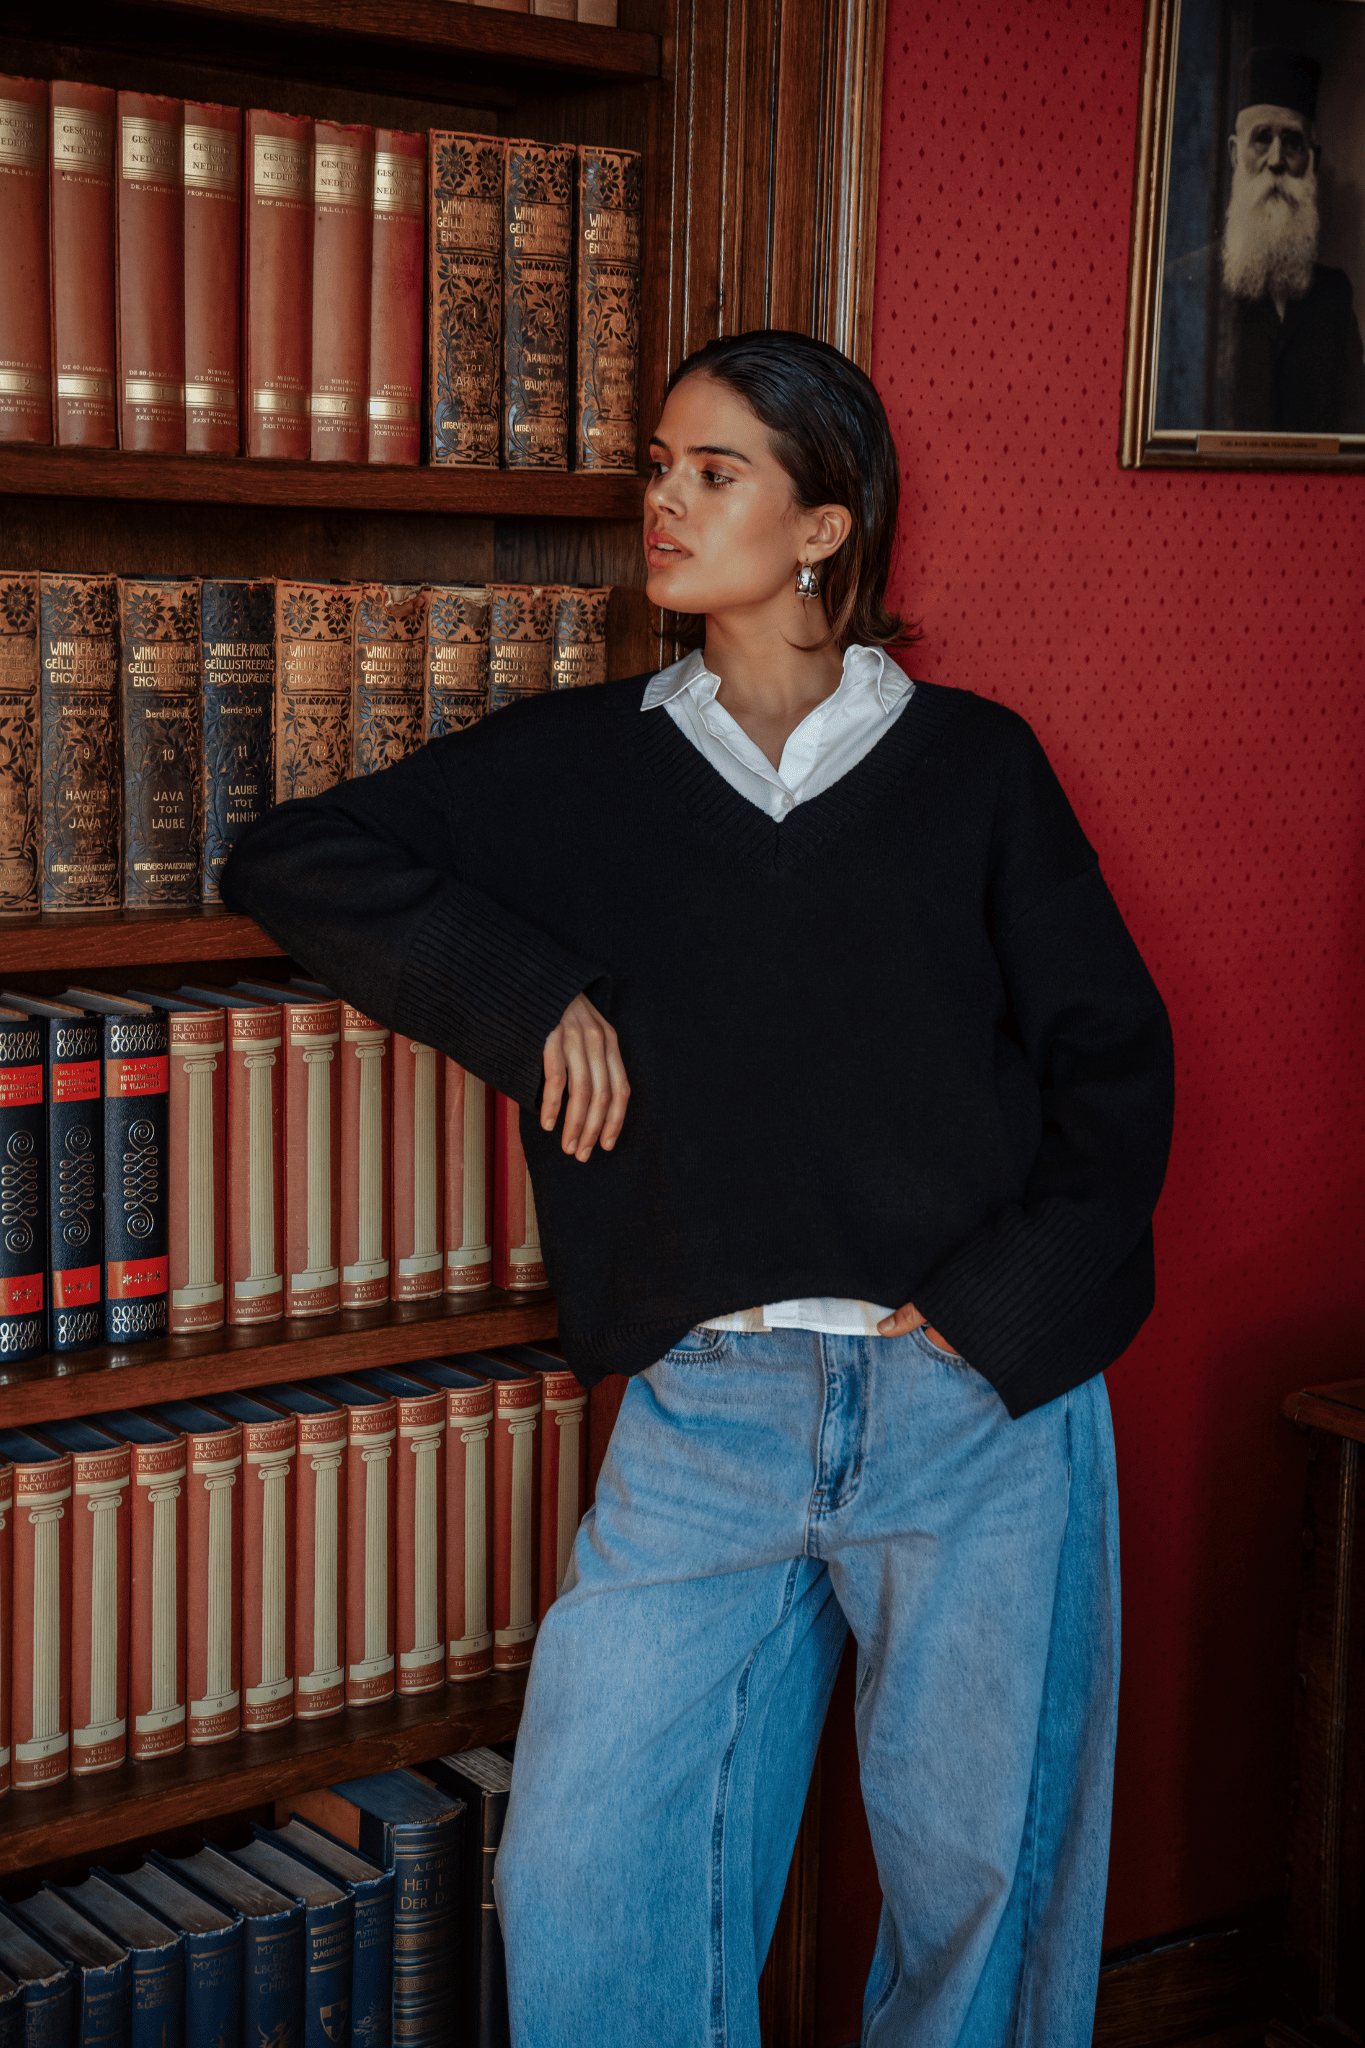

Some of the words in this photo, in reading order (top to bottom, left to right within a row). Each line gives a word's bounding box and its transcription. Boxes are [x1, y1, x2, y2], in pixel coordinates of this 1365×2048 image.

[12, 129, 31, 139] VAN
[82, 137, 100, 147] VAN
[151, 147, 169, 156] VAN
[211, 154, 228, 164] VAN
[281, 164, 298, 174] VAN
[339, 172, 356, 180] VAN
[395, 180, 410, 188] VAN
[257, 198, 274, 206] PROF.
[472, 307, 476, 318] 1
[543, 312, 550, 324] 2
[470, 350, 477, 360] A
[466, 364, 482, 372] TOT
[536, 366, 554, 376] TOT
[24, 378, 32, 390] 2
[92, 382, 100, 394] 3
[158, 388, 164, 399] 4
[216, 391, 223, 402] 5
[285, 398, 291, 408] 6
[341, 400, 348, 412] 7
[394, 404, 402, 414] 8
[204, 657, 274, 670] GEÏLLUSTREERDE
[220, 704, 243, 714] Derde
[245, 705, 263, 714] Druk
[83, 747, 90, 760] 9
[162, 748, 175, 761] 10
[238, 744, 248, 758] 11
[228, 784, 258, 796] LAUBE
[66, 790, 106, 801] HAWEIS
[152, 790, 184, 802] JAVA
[233, 798, 253, 808] TOT
[76, 804, 97, 814] TOT
[158, 804, 179, 814] TOT
[68, 818, 102, 829] JAVA
[152, 818, 186, 829] LAUBE
[292, 1014, 302, 1023] DE
[346, 1010, 354, 1018] DE
[172, 1024, 182, 1032] DE
[234, 1019, 242, 1028] DE
[120, 1082, 127, 1090] IN
[57, 1088, 64, 1096] IN
[500, 1390, 508, 1398] DE
[452, 1398, 460, 1406] DE
[402, 1408, 410, 1416] DE
[352, 1416, 361, 1424] DE
[302, 1424, 310, 1432] DE
[249, 1433, 258, 1441] DE
[194, 1442, 204, 1450] DE
[138, 1454, 147, 1462] DE
[78, 1463, 87, 1472] DE
[19, 1474, 28, 1482] DE
[216, 1700, 223, 1708] 18
[162, 1716, 168, 1724] 17
[42, 1744, 50, 1752] 15
[414, 1862, 424, 1872] A.
[425, 1861, 434, 1871] E.
[404, 1878, 430, 1892] HET
[400, 1896, 428, 1910] DER
